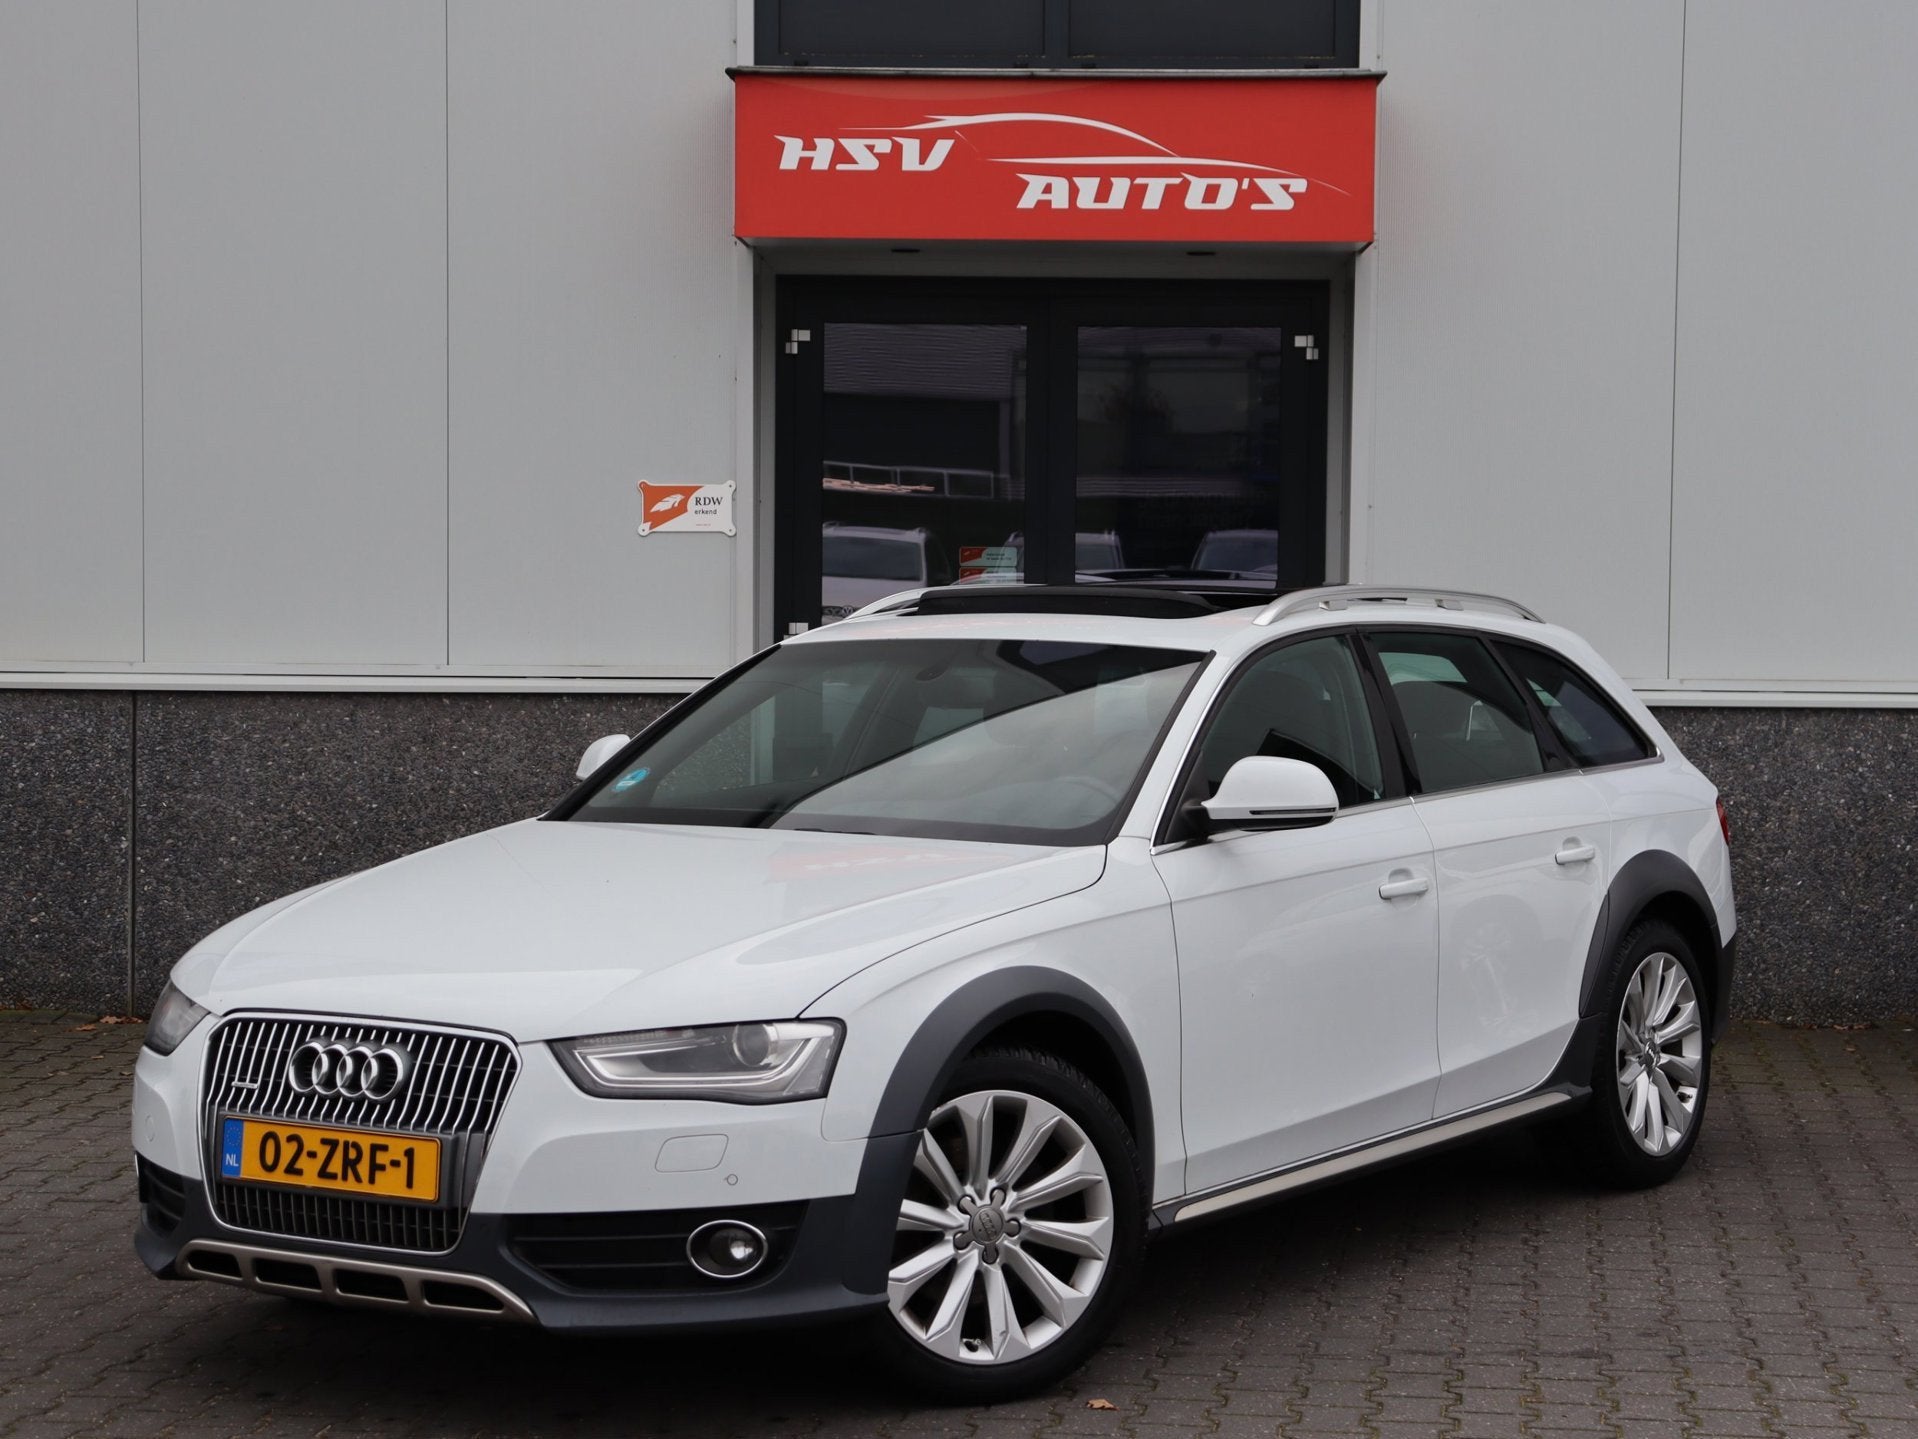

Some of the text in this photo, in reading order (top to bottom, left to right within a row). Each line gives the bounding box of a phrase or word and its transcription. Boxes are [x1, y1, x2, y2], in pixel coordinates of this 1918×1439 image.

[774, 135, 955, 172] HSV
[1015, 172, 1308, 211] AUTO'S
[694, 496, 723, 506] RDW
[225, 1153, 239, 1168] NL
[258, 1130, 415, 1190] 02-ZRF-1
